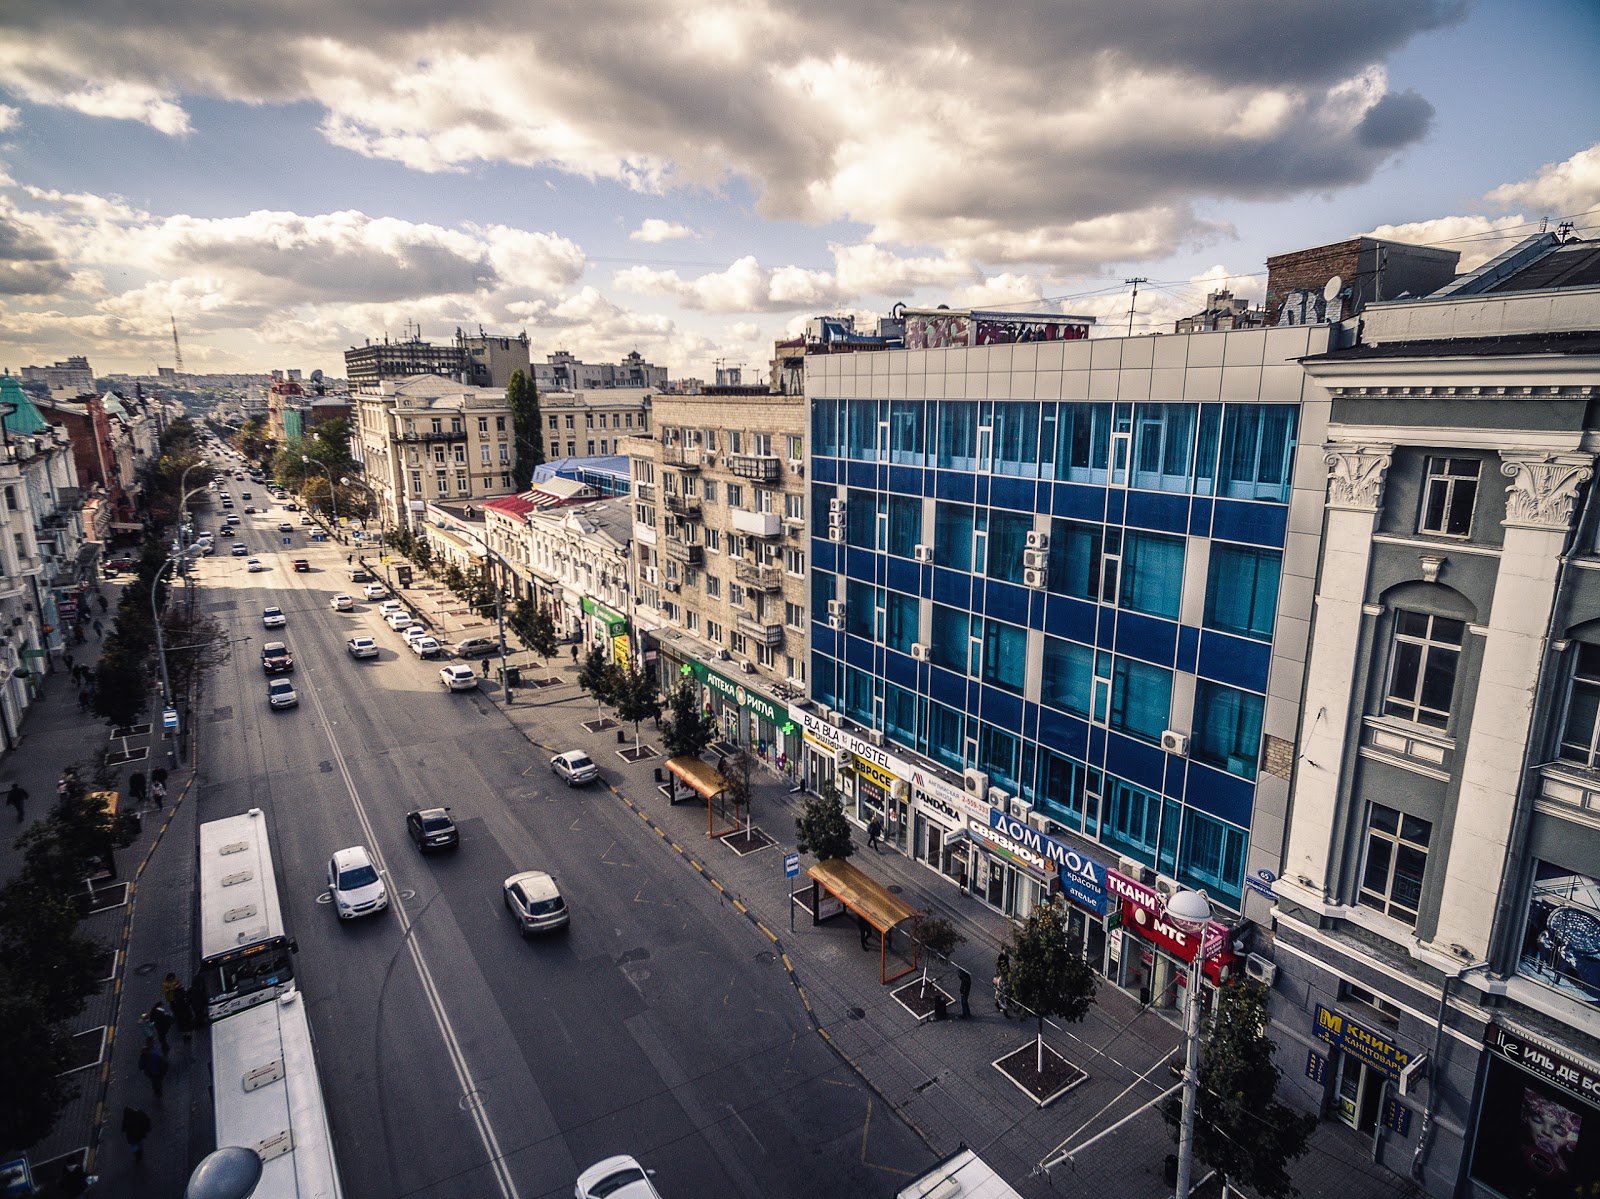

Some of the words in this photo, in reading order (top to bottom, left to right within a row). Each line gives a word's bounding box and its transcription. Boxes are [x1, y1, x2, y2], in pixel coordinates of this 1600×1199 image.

[707, 672, 735, 697] АПТЕКА
[747, 693, 775, 720] РИГЛА
[804, 715, 820, 735] BLA
[822, 726, 839, 743] BLA
[850, 738, 891, 770] HOSTEL
[916, 789, 961, 822] PANDORA
[995, 815, 1041, 853] ДОМ
[1046, 841, 1098, 883] МОД
[1067, 871, 1101, 894] красоты
[1070, 888, 1097, 907] ателье
[1108, 874, 1155, 911] ТКАНИ
[1153, 918, 1187, 947] МТС
[1346, 1023, 1409, 1066] КНИГИ
[1523, 1046, 1555, 1071] ИЛЬ
[1556, 1064, 1580, 1084] ДЕ
